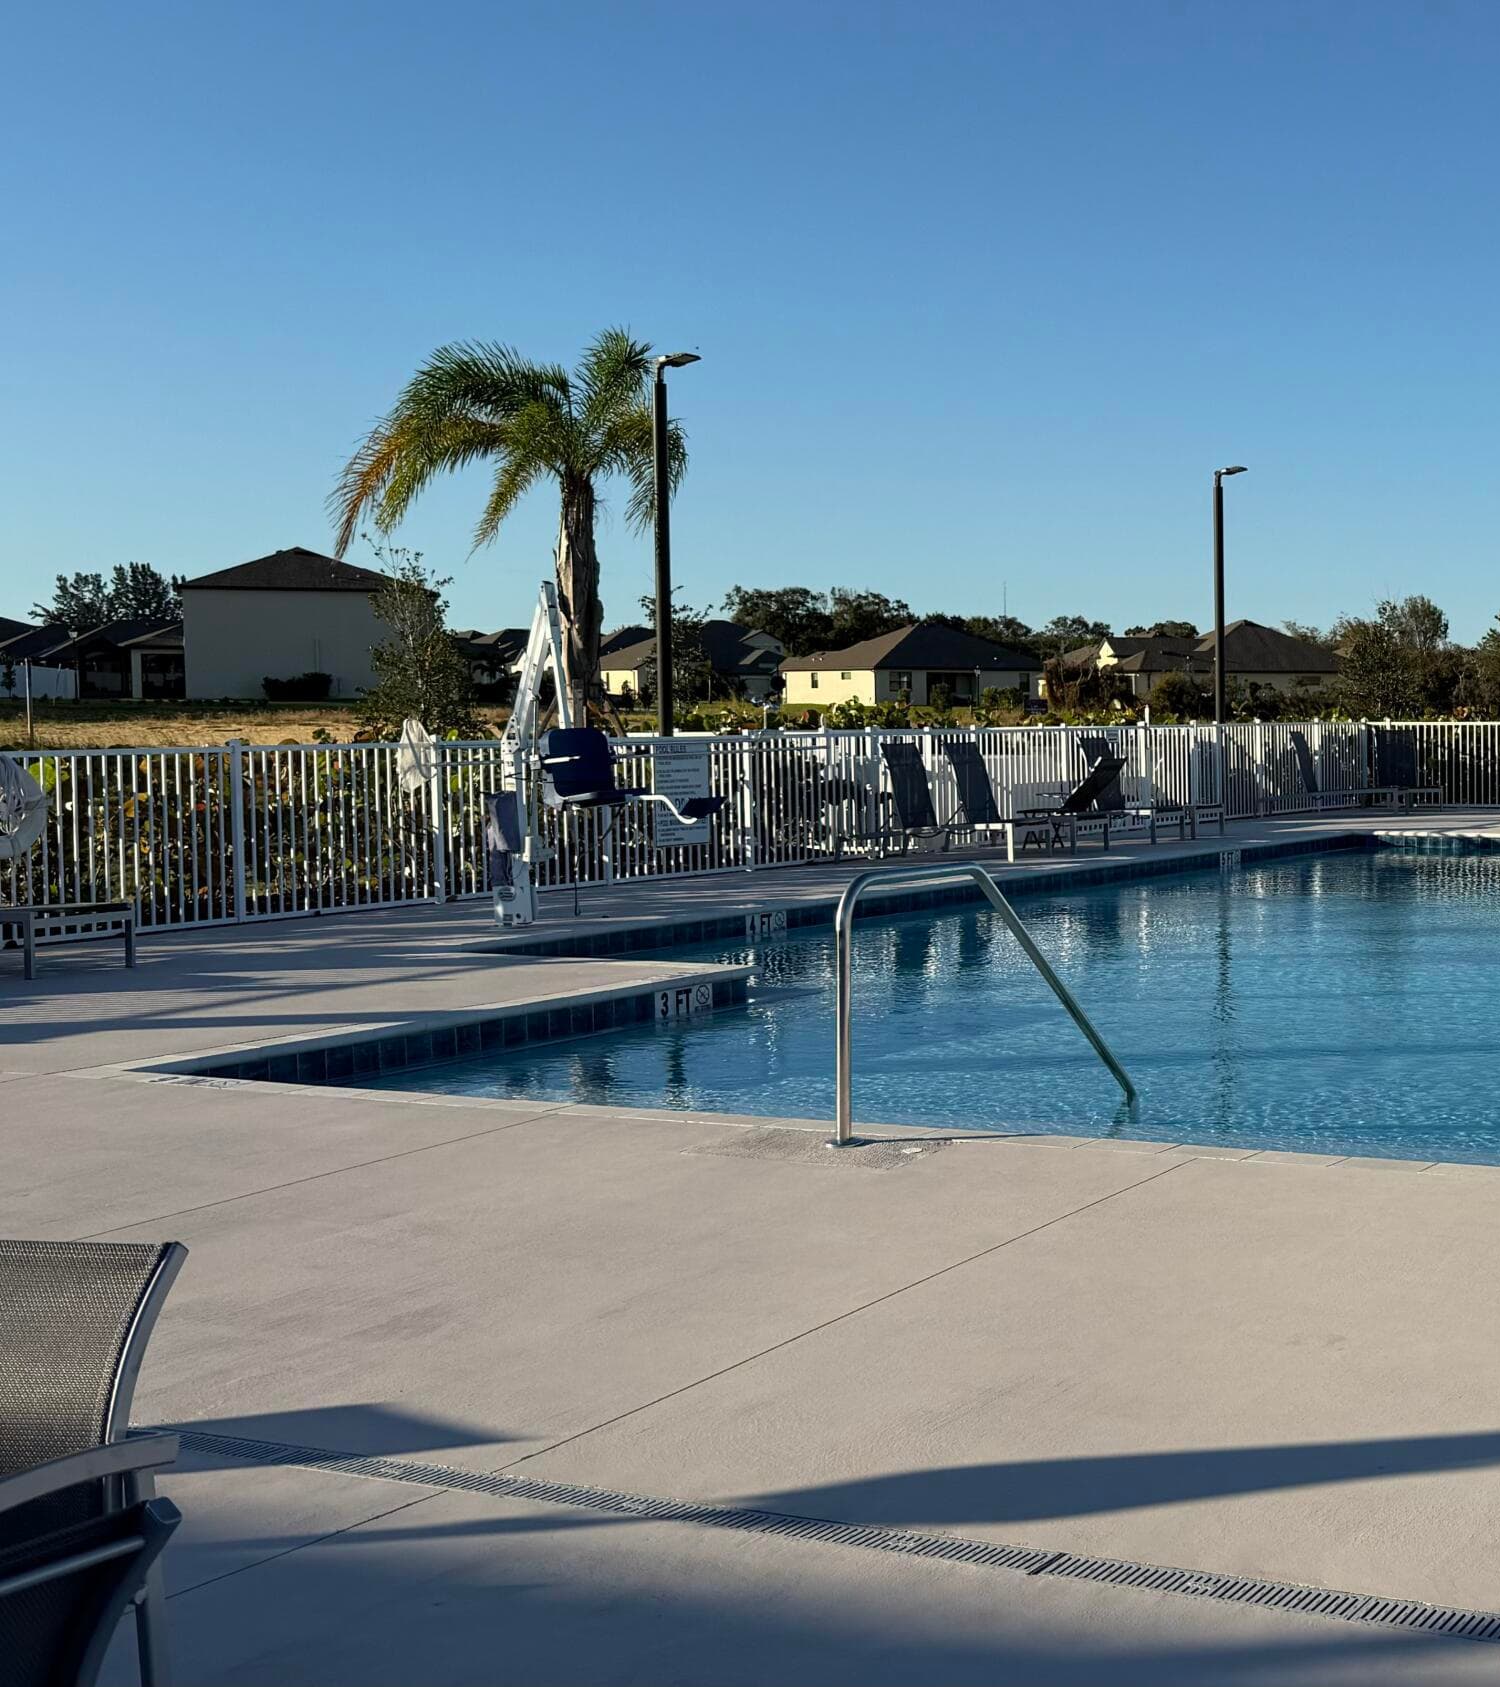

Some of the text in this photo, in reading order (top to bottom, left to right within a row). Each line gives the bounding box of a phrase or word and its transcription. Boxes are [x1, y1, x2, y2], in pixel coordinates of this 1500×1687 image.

[749, 913, 772, 935] 4 FT
[660, 988, 693, 1017] 3 FT
